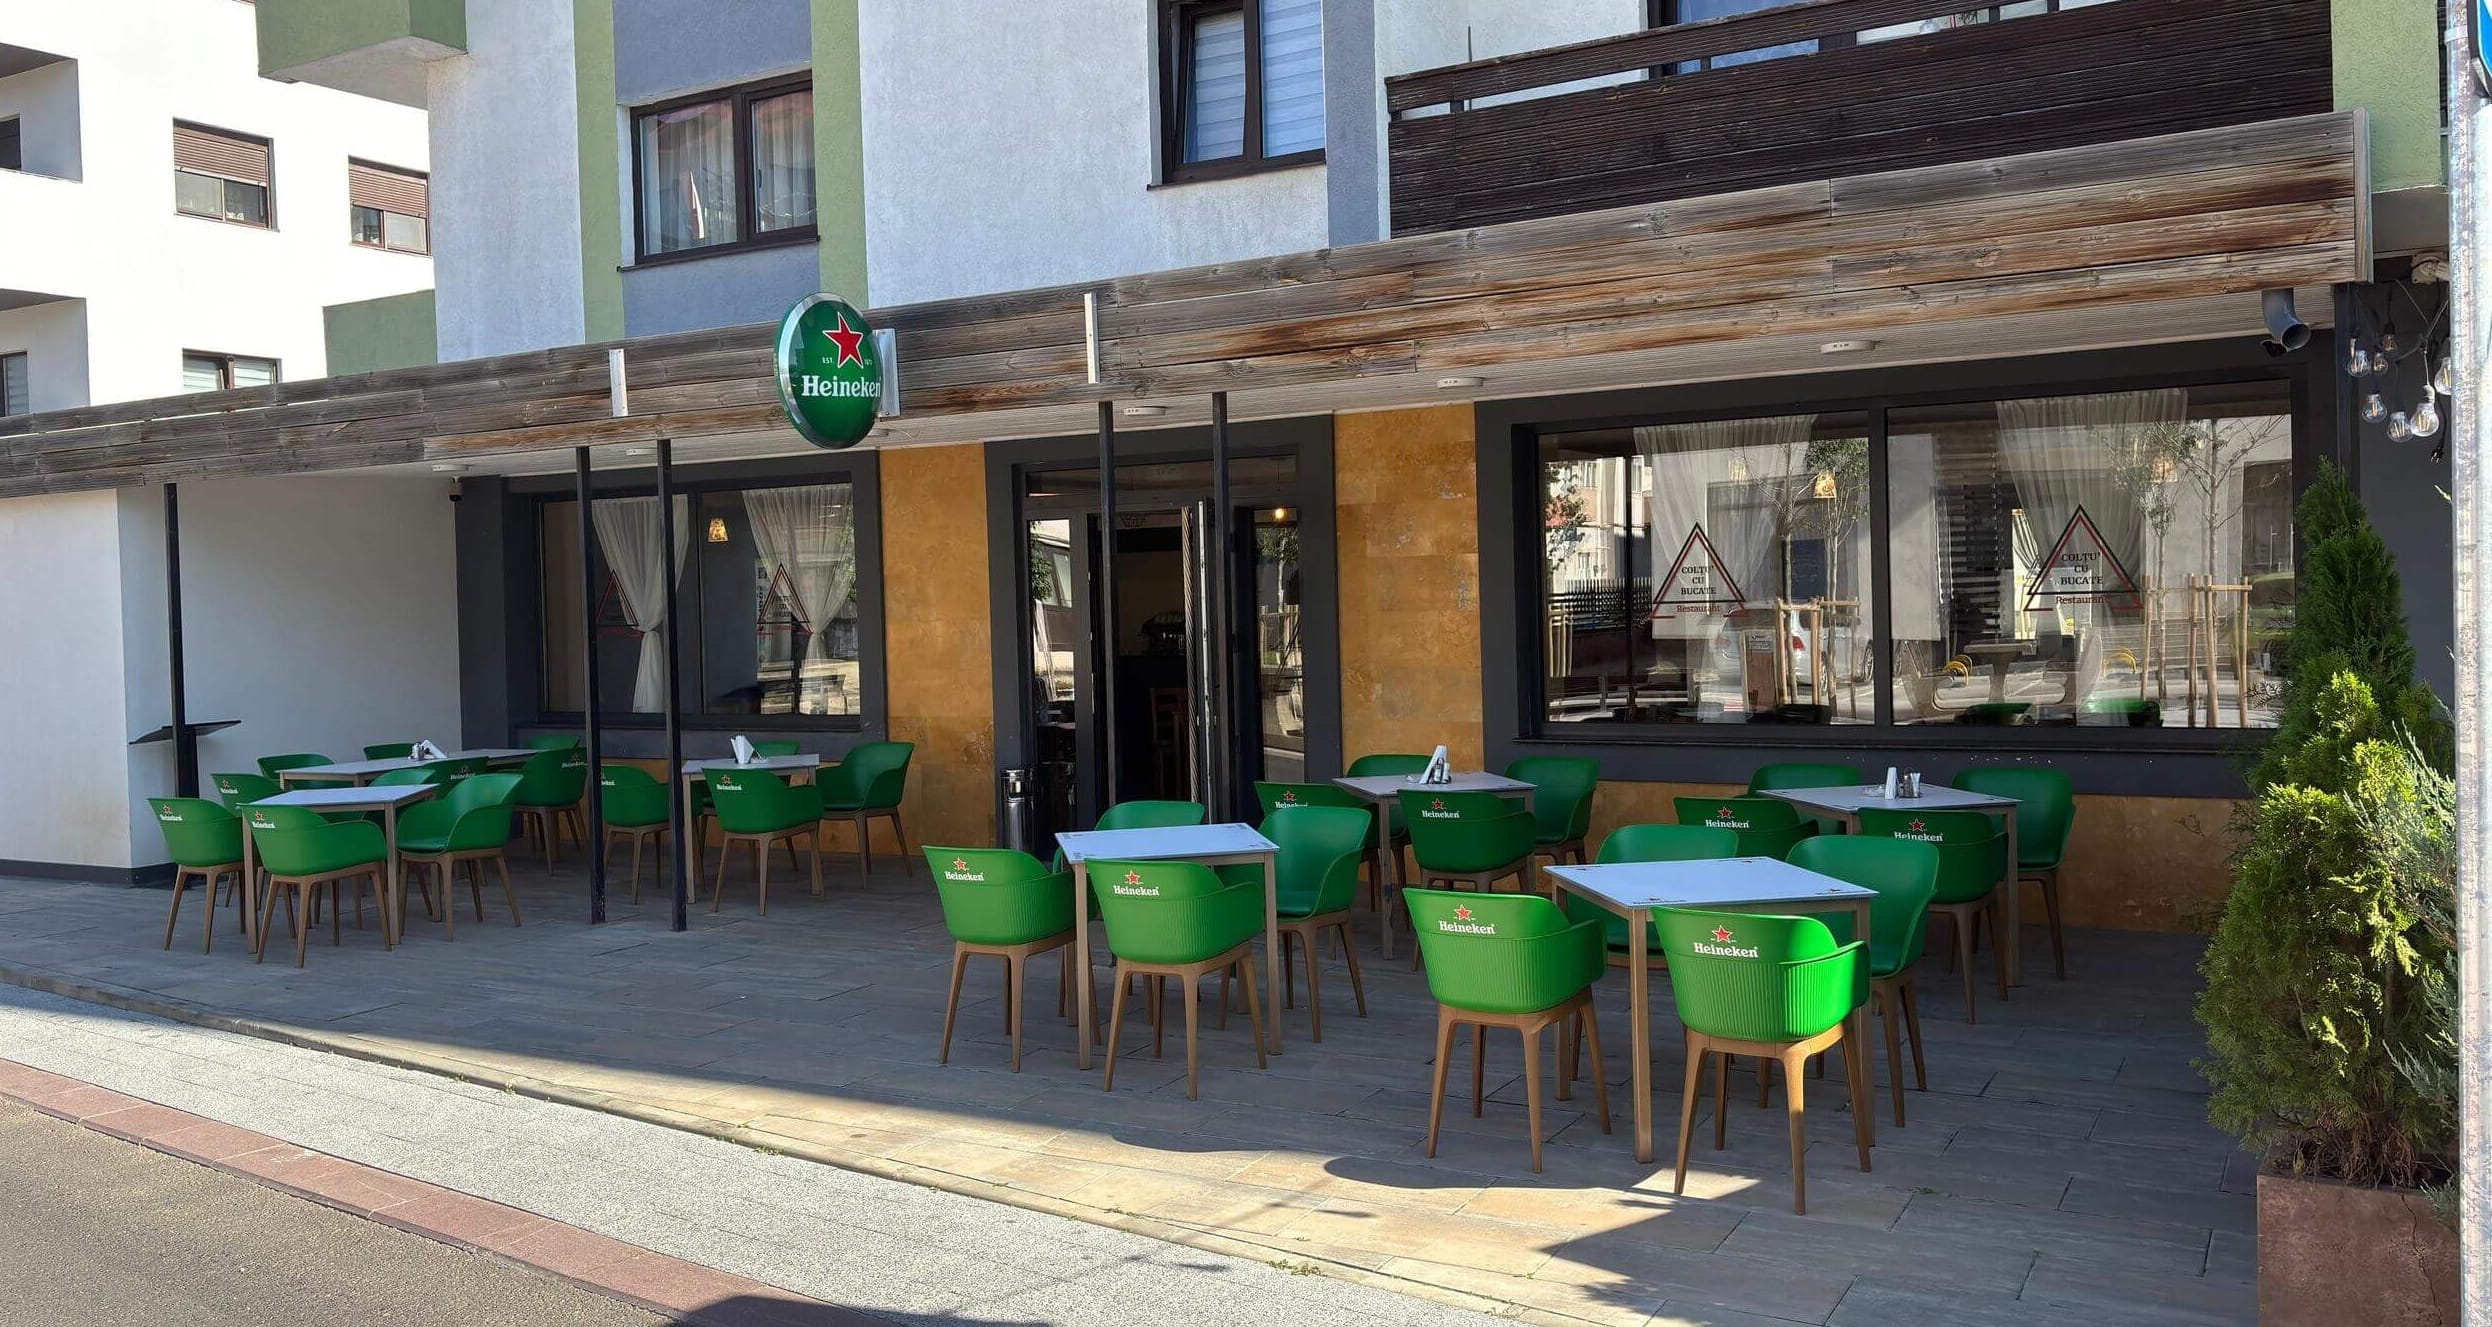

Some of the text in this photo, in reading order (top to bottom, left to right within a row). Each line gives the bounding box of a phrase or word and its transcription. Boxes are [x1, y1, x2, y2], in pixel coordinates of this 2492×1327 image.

[801, 375, 881, 397] Heineken
[2074, 565, 2088, 573] CU
[1692, 577, 1704, 585] CU
[2060, 576, 2103, 585] BUCATE
[1681, 586, 1717, 595] BUCATE
[1421, 810, 1460, 819] Heineken
[1705, 819, 1750, 828] Heineken
[1894, 831, 1943, 842] Heineken
[944, 871, 985, 882] Heineken
[1113, 885, 1160, 896] Heineken
[1438, 920, 1496, 934] Heineken
[1693, 942, 1758, 958] Heineken
